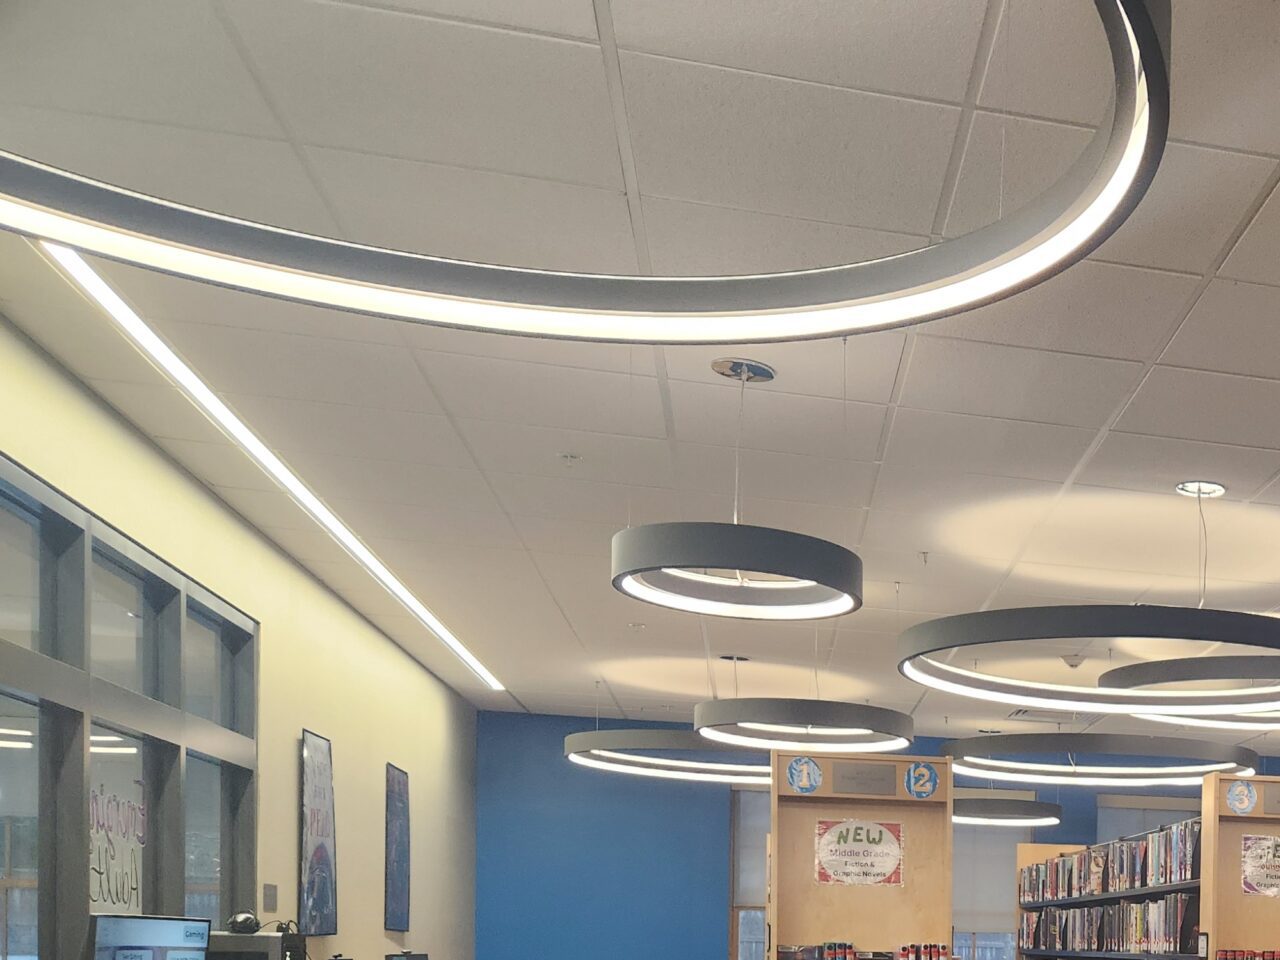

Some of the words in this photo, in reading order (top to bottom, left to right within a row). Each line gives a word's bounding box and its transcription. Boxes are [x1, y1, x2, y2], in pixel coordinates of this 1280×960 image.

[798, 764, 810, 788] 1
[914, 766, 932, 792] 2
[1234, 785, 1250, 809] 3
[836, 826, 883, 846] NEW
[829, 849, 861, 858] Middle
[862, 849, 891, 858] Grade
[862, 869, 887, 878] Novels
